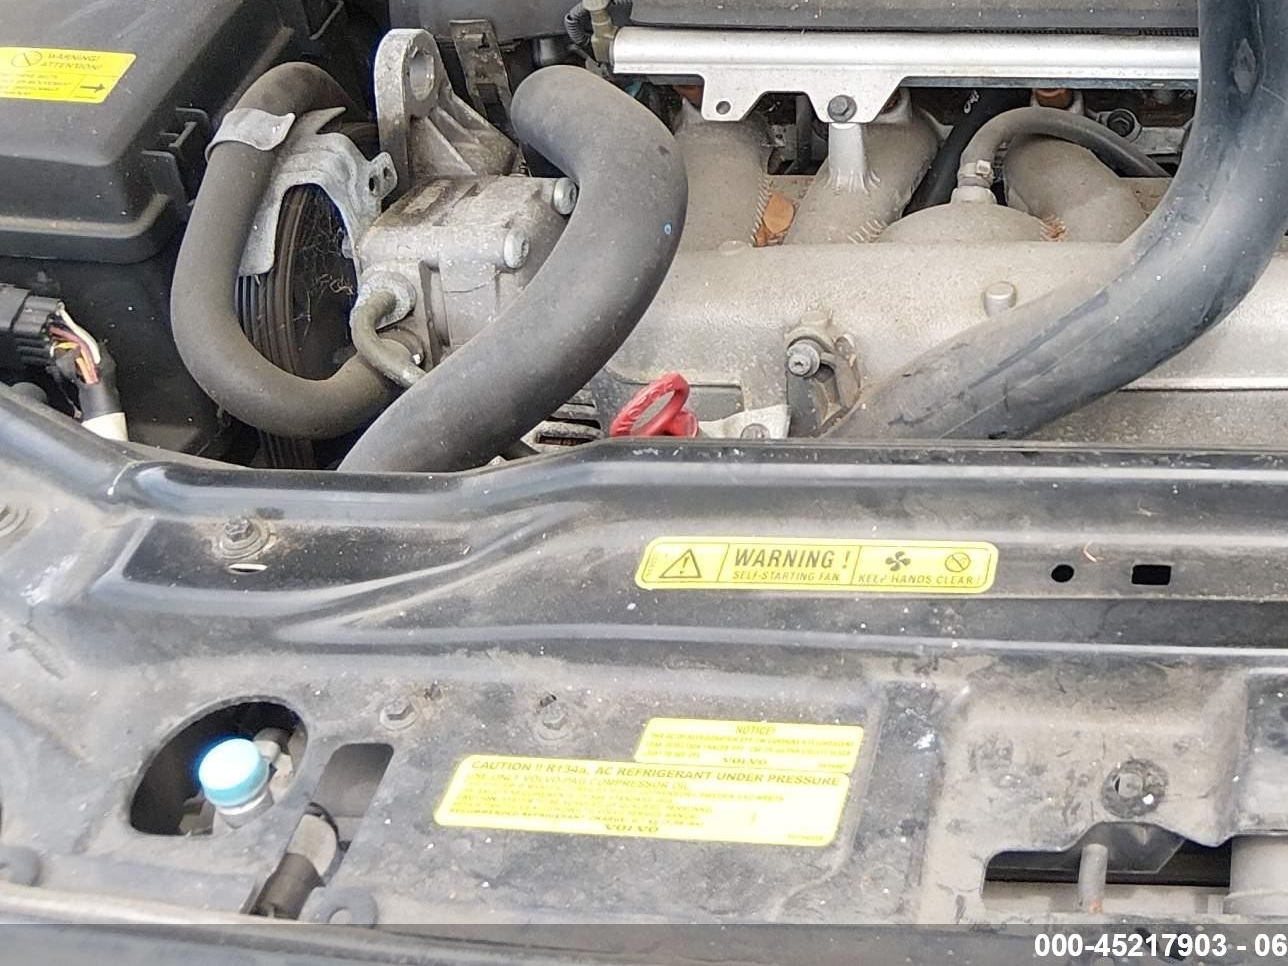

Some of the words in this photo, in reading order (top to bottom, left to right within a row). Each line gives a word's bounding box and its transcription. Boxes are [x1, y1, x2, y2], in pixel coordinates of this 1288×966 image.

[735, 548, 835, 569] WARNING
[732, 570, 815, 581] SELF-STARTING
[818, 572, 840, 582] FAN
[891, 575, 932, 584] HANDS
[472, 761, 532, 771] CAUTION
[595, 766, 612, 776] AC
[616, 767, 712, 780] REFRIGERANT
[716, 772, 764, 783] UNDER
[767, 774, 840, 787] PRESSURE
[605, 823, 659, 833] VOLVO
